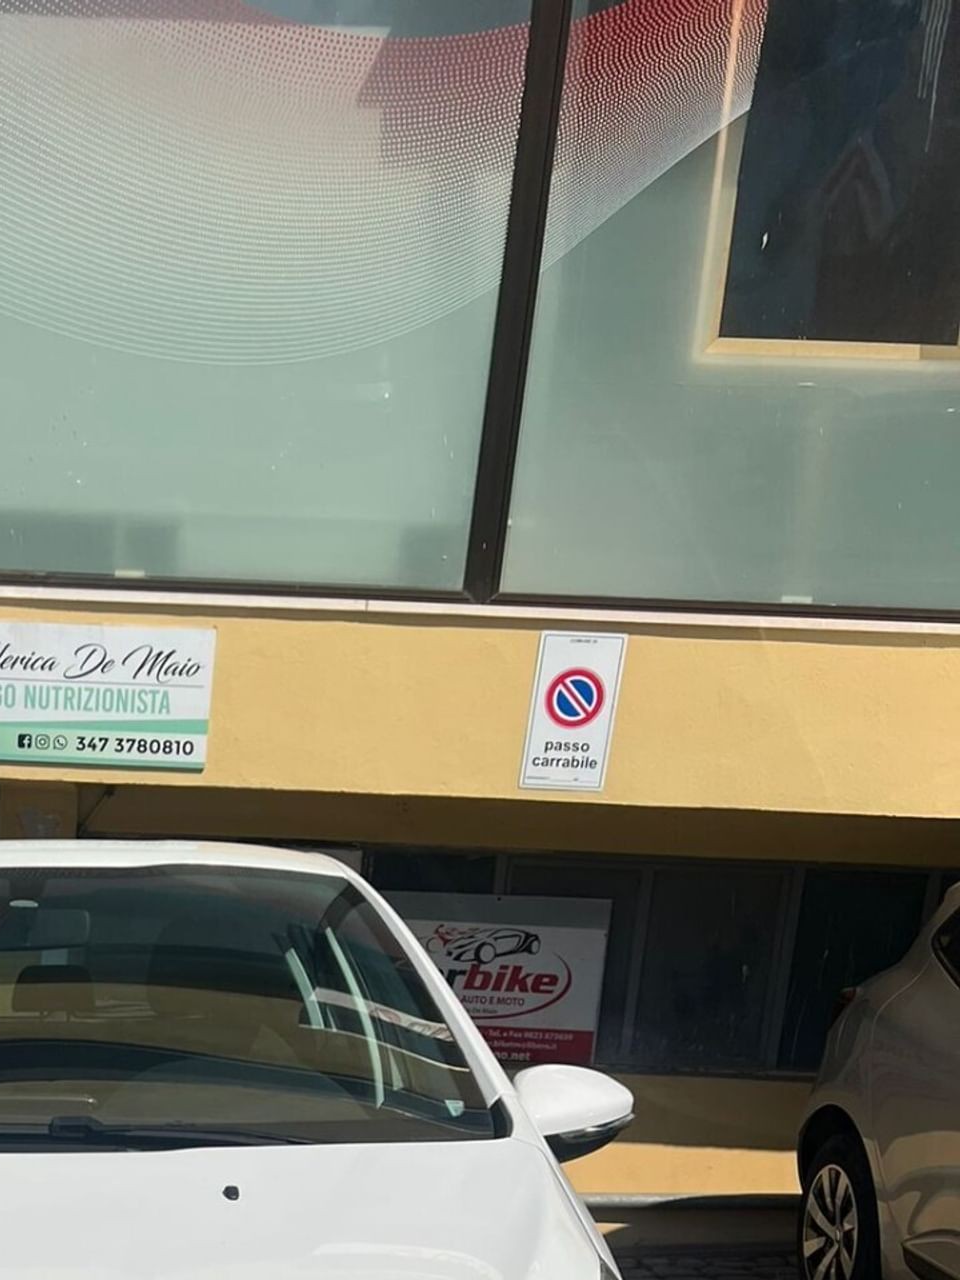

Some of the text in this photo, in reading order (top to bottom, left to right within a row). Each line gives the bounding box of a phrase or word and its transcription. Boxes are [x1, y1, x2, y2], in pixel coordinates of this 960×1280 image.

[63, 643, 116, 680] De
[121, 645, 203, 684] Maio
[23, 683, 171, 716] NUTRIZIONISTA
[75, 736, 194, 756] 347 3780810
[544, 740, 591, 753] passo
[532, 756, 598, 769] carrabile
[440, 963, 559, 994] rbike
[461, 995, 487, 1005] AUTO
[496, 997, 525, 1007] MOTO
